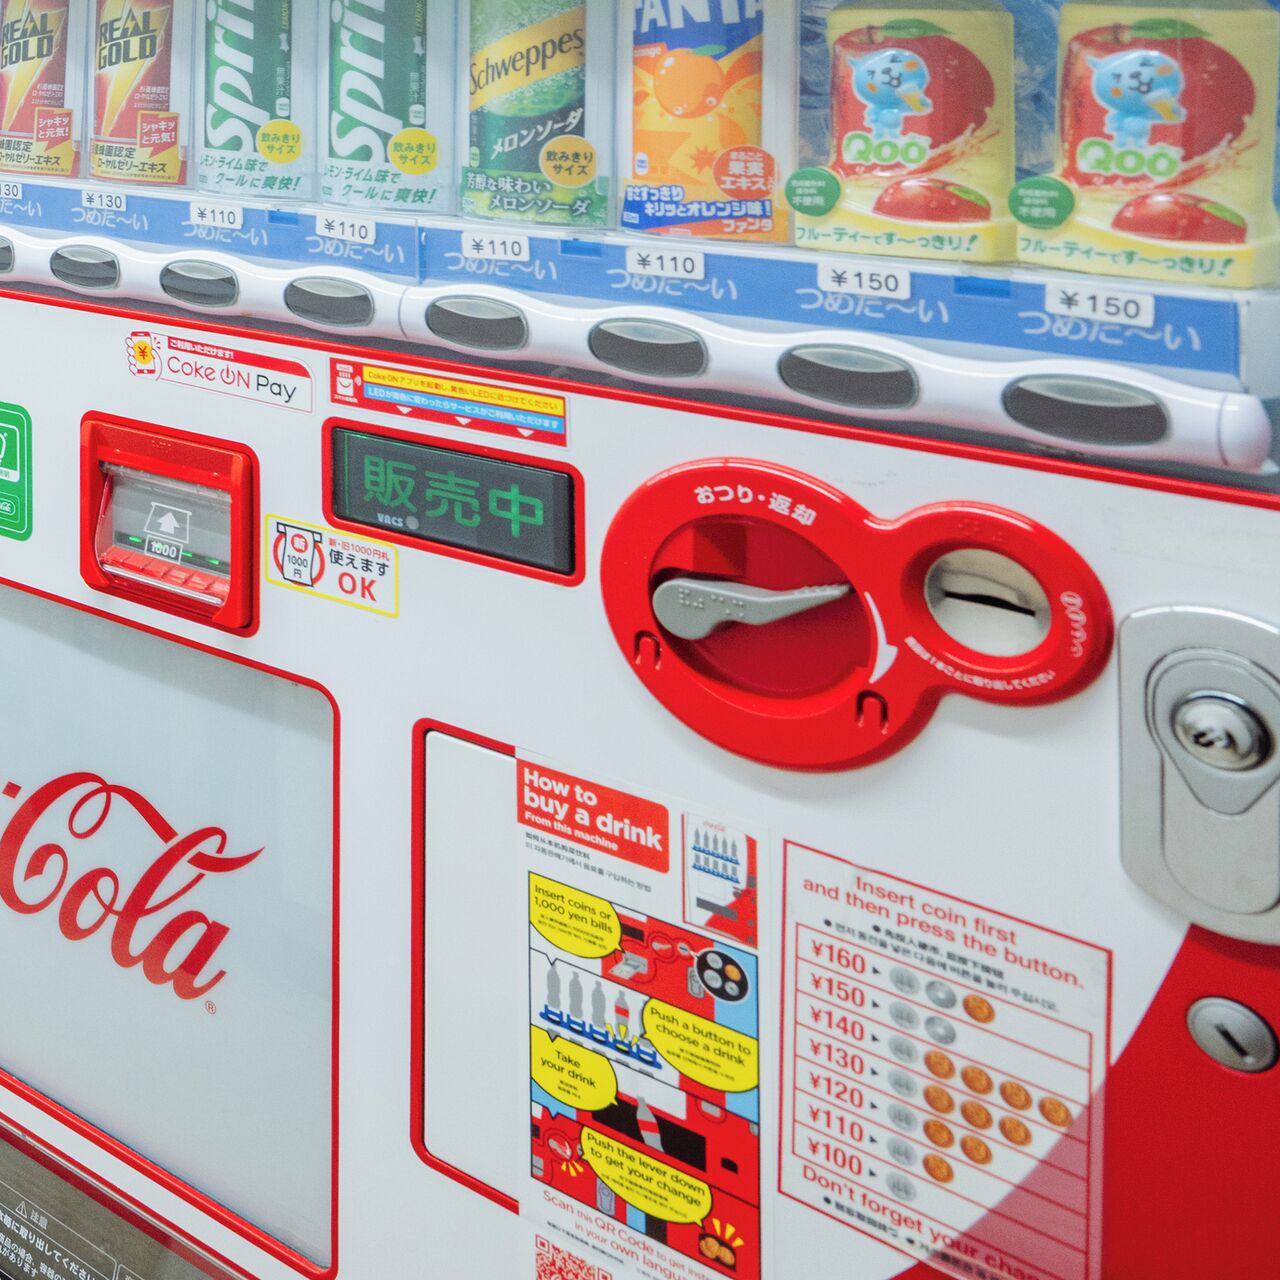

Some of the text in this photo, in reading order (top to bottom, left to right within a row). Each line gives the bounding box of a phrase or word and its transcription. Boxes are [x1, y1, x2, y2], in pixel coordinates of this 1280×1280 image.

[0, 35, 53, 69] GOLD
[98, 36, 157, 71] GOLD
[468, 28, 586, 98] Schweppes
[843, 131, 927, 166] Qoo
[1077, 139, 1180, 176] Qoo
[471, 238, 522, 258] ¥110
[636, 253, 695, 275] ¥110
[830, 268, 899, 292] ¥150
[1060, 291, 1141, 319] ¥150
[167, 356, 215, 382] Coke
[256, 374, 297, 403] Pay
[363, 455, 544, 538] 販売中
[693, 482, 818, 528] おつり・返却
[287, 554, 308, 568] 1000
[293, 568, 302, 579] 円
[329, 549, 390, 577] 使えます
[338, 572, 377, 601] OK
[524, 767, 598, 806] How to
[524, 785, 662, 851] buy a drink
[525, 811, 619, 851] From this machine
[534, 885, 612, 920] Insert coins or
[534, 897, 565, 916] 1,000
[568, 908, 588, 925] yen
[590, 916, 613, 934] bills
[855, 876, 1017, 945] Insert coin first
[802, 878, 840, 900] and
[845, 890, 890, 919] then
[896, 911, 956, 943] press
[962, 933, 997, 957] the
[1004, 947, 1085, 989] button.
[812, 940, 866, 975] ¥160
[811, 973, 866, 1009] ¥150
[650, 1006, 751, 1056] Push a button to
[810, 1006, 865, 1042] ¥140
[555, 1050, 581, 1068] Take
[656, 1022, 699, 1047] choose
[702, 1041, 710, 1053] a
[713, 1045, 745, 1066] drink
[810, 1039, 864, 1075] ¥130
[541, 1057, 596, 1088] your drink
[809, 1072, 864, 1109] ¥120
[809, 1105, 863, 1142] ¥110
[587, 1133, 706, 1195] Push the lever down
[808, 1138, 863, 1175] ¥100
[591, 1146, 603, 1159] to
[605, 1155, 624, 1173] get
[627, 1166, 653, 1184] your
[657, 1176, 701, 1208] change
[543, 1190, 574, 1214] Scan
[595, 1217, 616, 1237] QR
[618, 1229, 655, 1255] Code
[802, 1164, 856, 1201] Don't
[860, 1192, 923, 1233] forget
[929, 1225, 978, 1257] your
